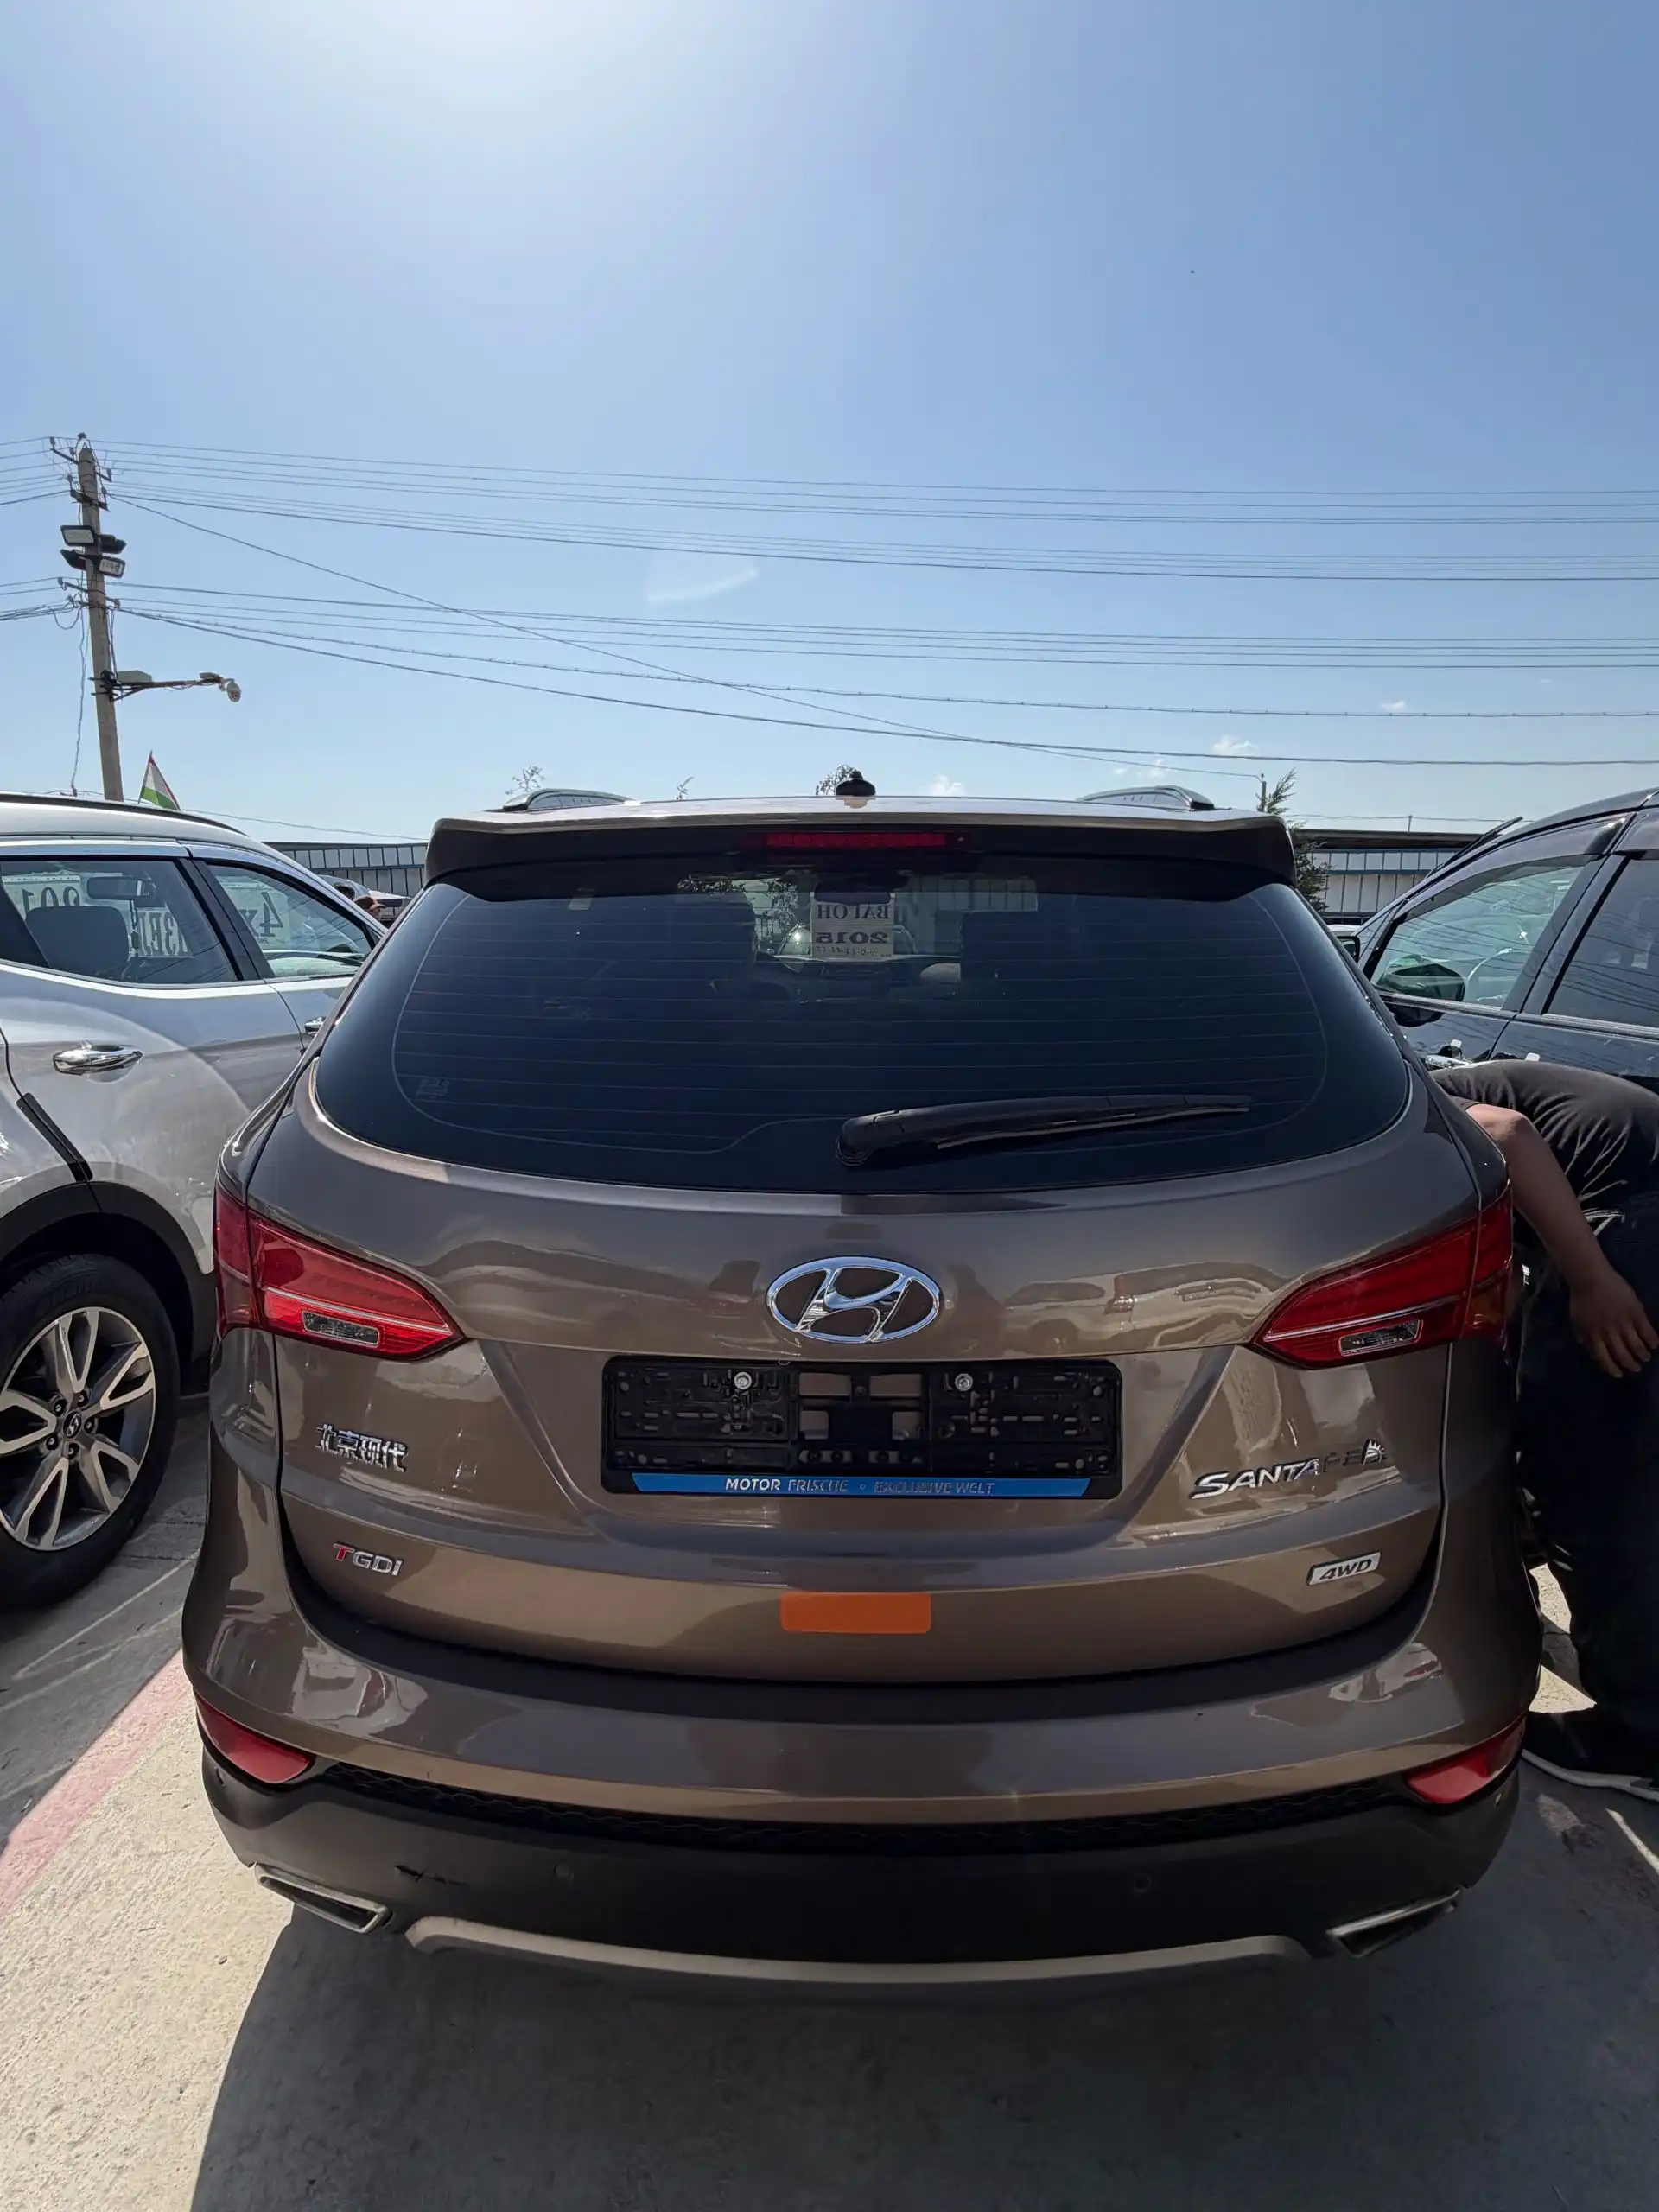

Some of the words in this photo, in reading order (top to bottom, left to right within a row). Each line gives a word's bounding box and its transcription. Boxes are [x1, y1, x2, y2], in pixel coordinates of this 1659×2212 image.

[315, 1424, 410, 1472] 北京现代
[725, 1478, 781, 1491] MOTOR
[787, 1479, 849, 1492] FRISCHE
[955, 1483, 995, 1495] WELT
[1192, 1457, 1320, 1499] SANTA
[1319, 1559, 1372, 1580] 4WD
